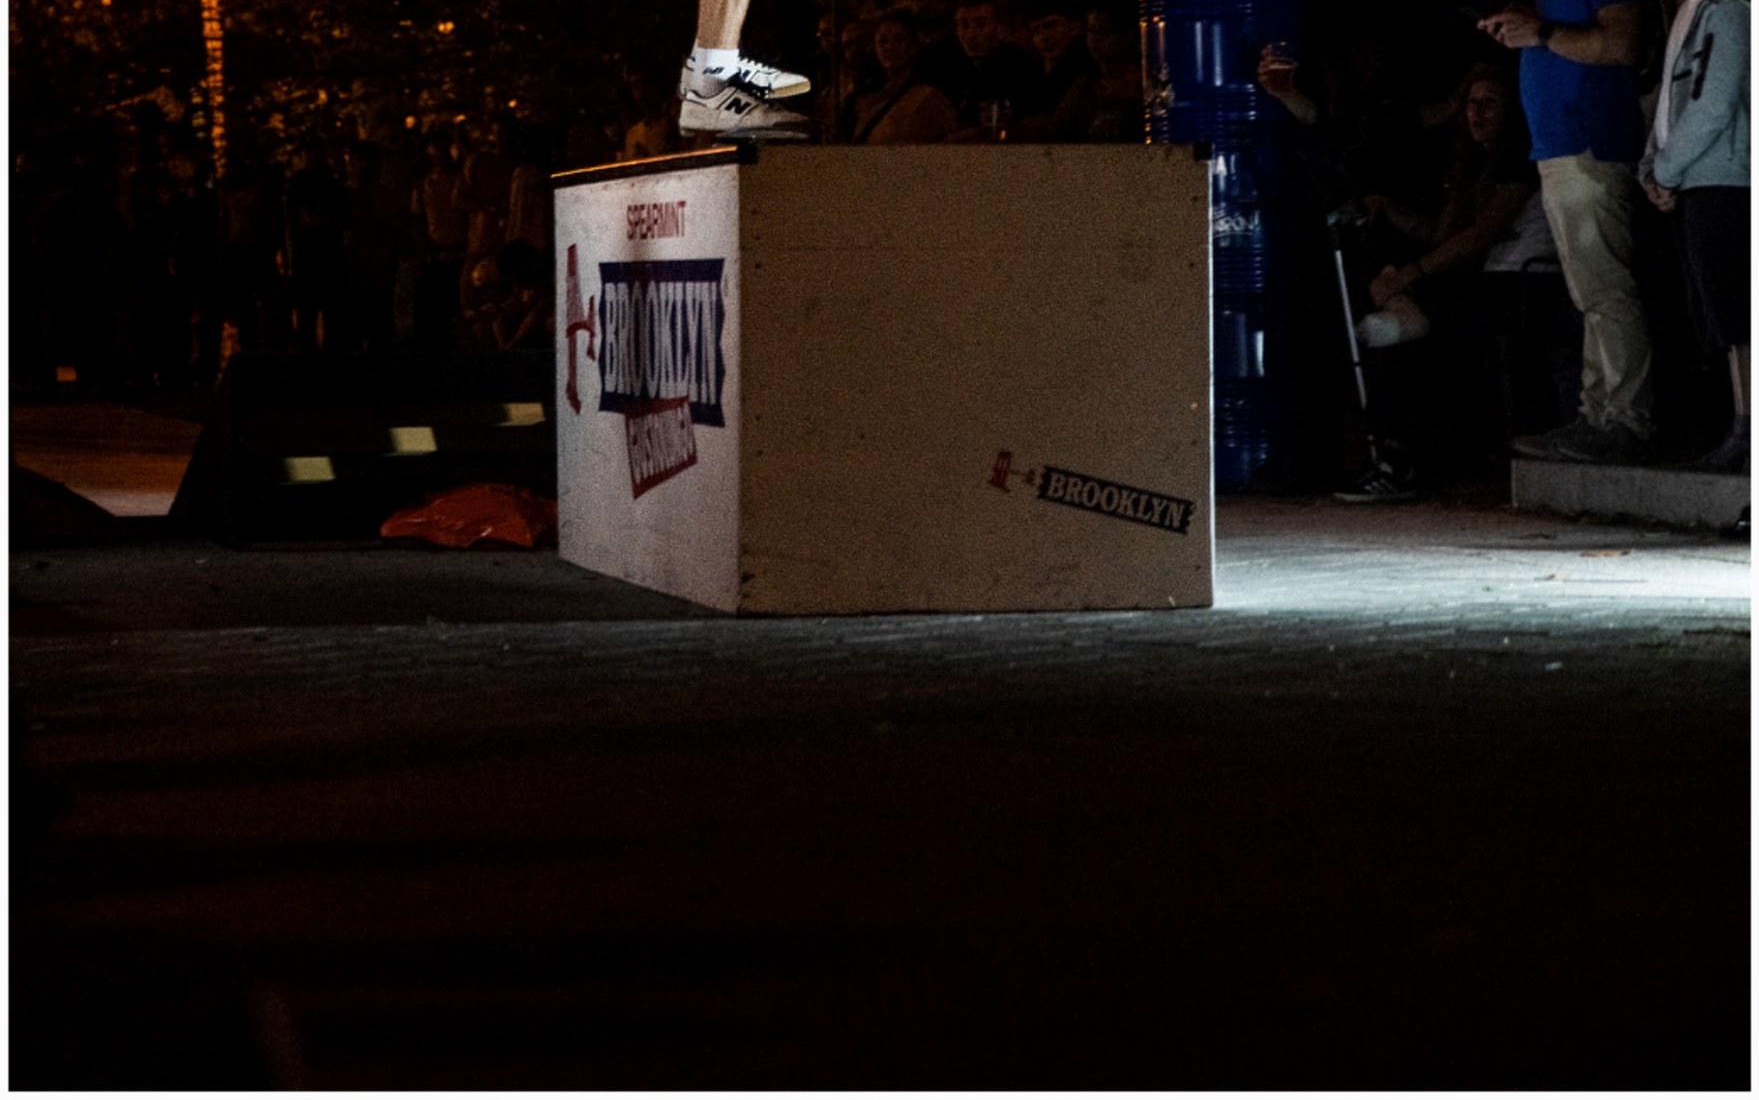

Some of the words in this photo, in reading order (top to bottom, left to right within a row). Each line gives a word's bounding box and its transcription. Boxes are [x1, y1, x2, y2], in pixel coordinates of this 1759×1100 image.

[725, 98, 752, 114] N
[627, 201, 686, 239] SPEARMINT
[604, 280, 717, 405] BROOKLYN
[1048, 472, 1185, 528] BROOKLYN
